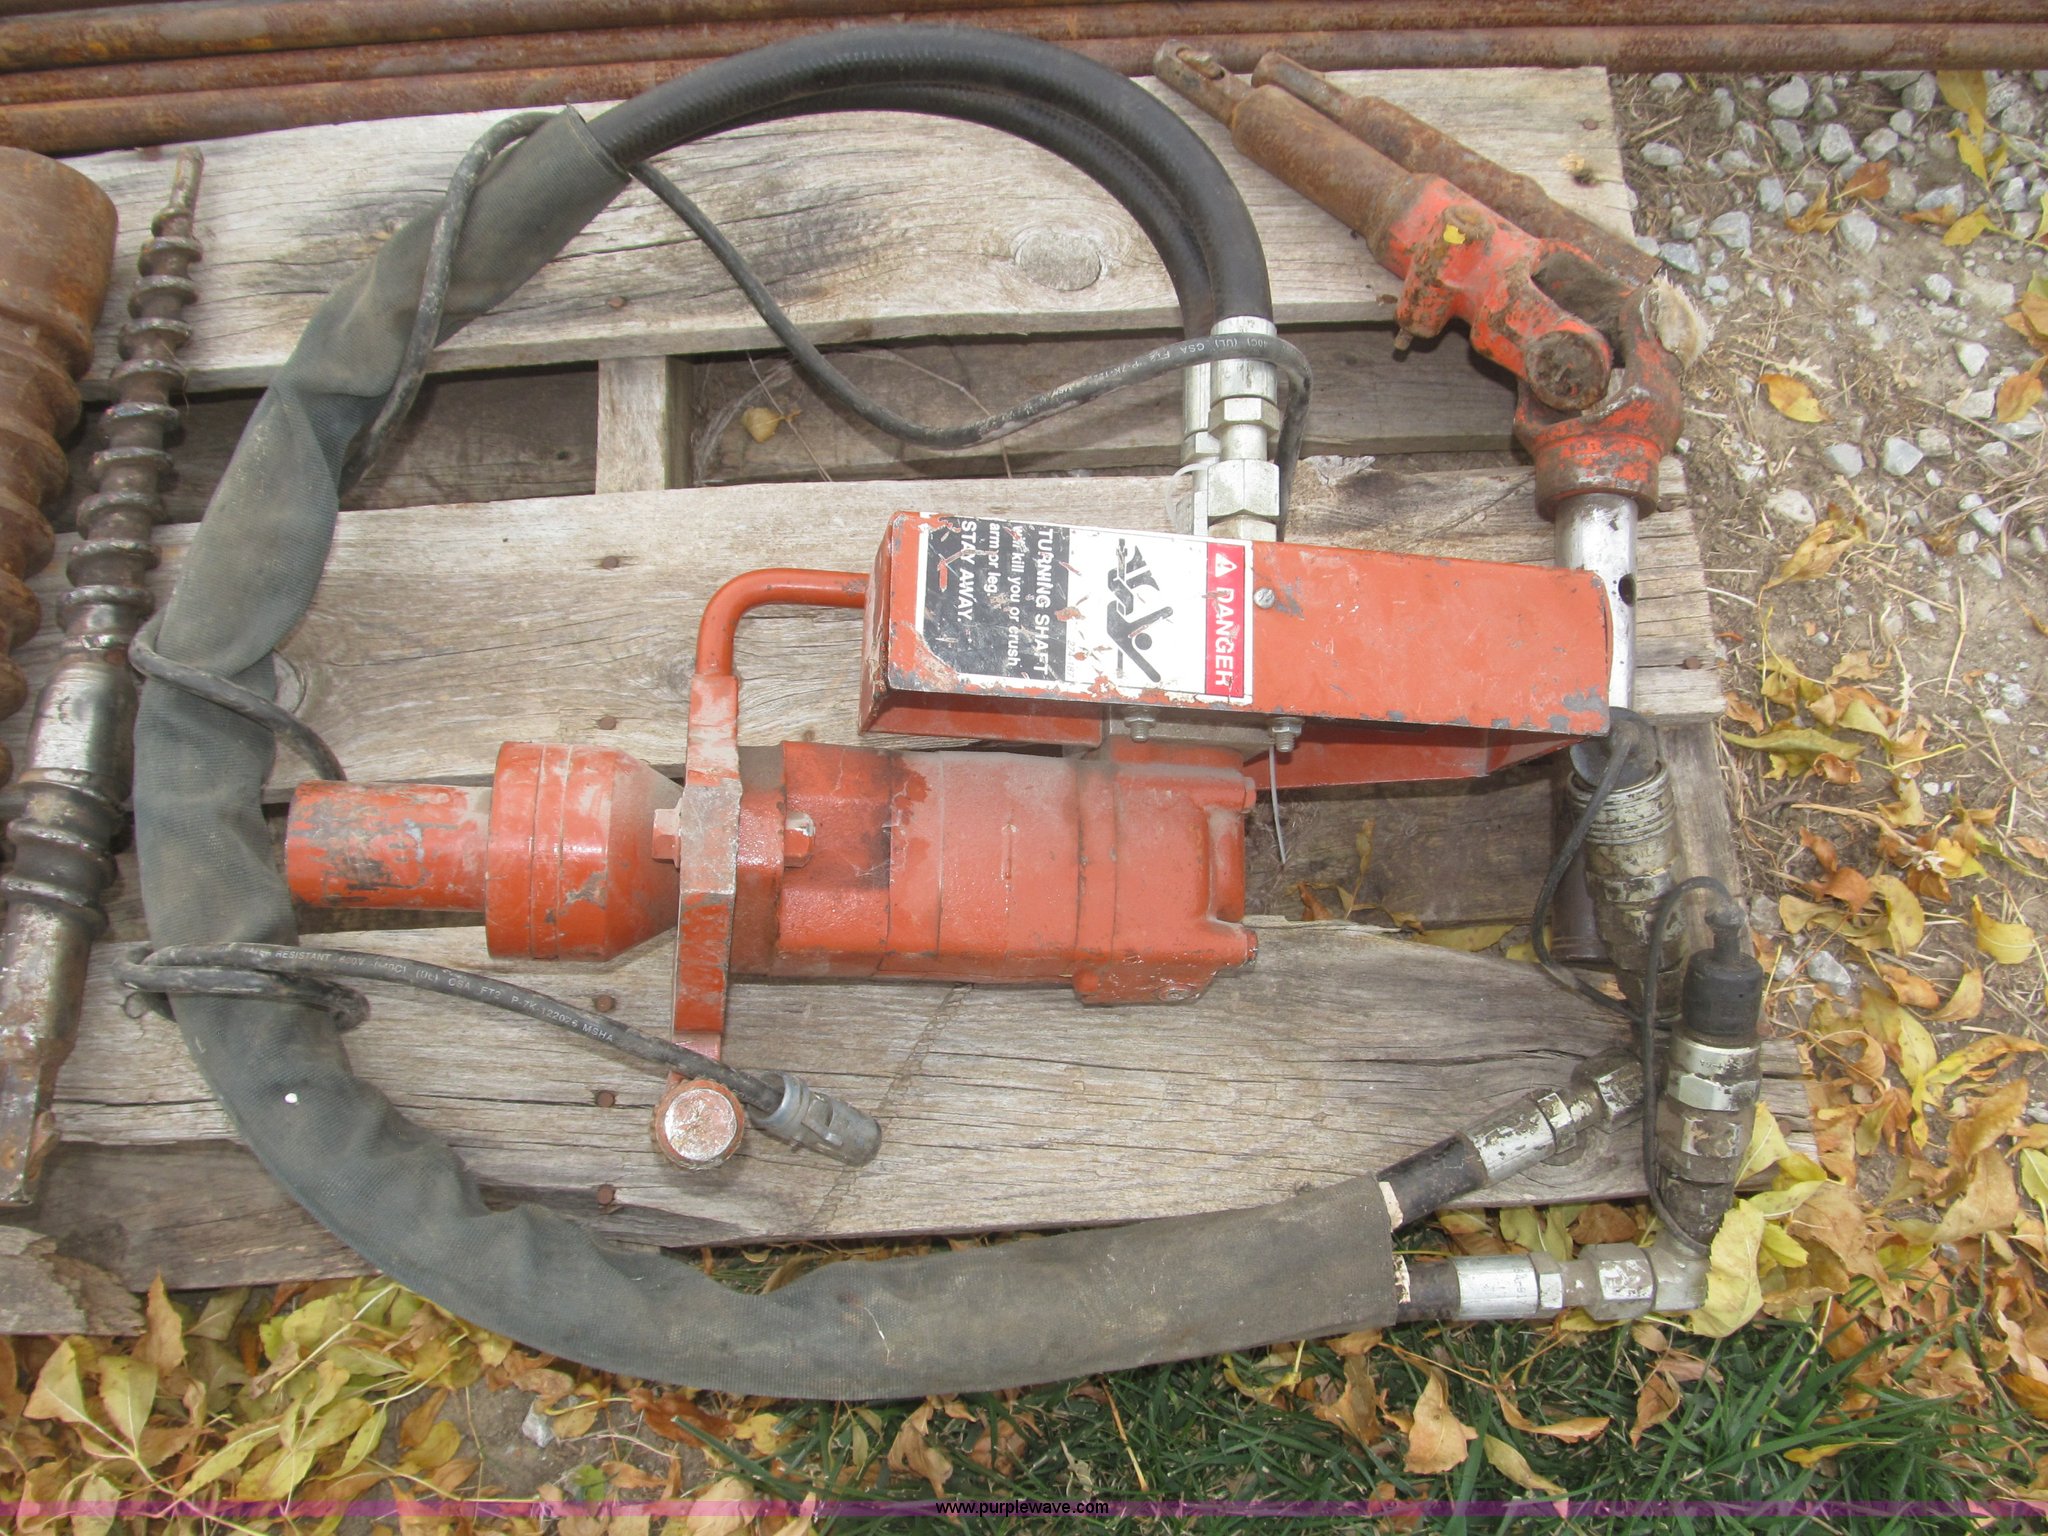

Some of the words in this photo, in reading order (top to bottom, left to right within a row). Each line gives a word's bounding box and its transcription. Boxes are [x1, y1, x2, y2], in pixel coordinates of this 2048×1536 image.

[1179, 342, 1205, 354] CSA
[960, 520, 977, 565] STAY
[989, 522, 1001, 548] arm
[989, 554, 1000, 568] or
[1011, 552, 1025, 573] kill
[1035, 528, 1054, 608] TURNING
[957, 567, 976, 622] AWAY.
[983, 572, 1001, 597] leg.
[1007, 576, 1021, 602] you
[1009, 607, 1020, 622] or
[1007, 625, 1021, 667] crush
[1033, 613, 1051, 675] SHAFT
[1213, 587, 1233, 687] DANGER
[275, 951, 332, 962] RESISTANT
[448, 977, 471, 990] CSA
[480, 985, 502, 1000] FT2
[511, 995, 579, 1028] P-7K-122026
[582, 1023, 614, 1043] MSHA
